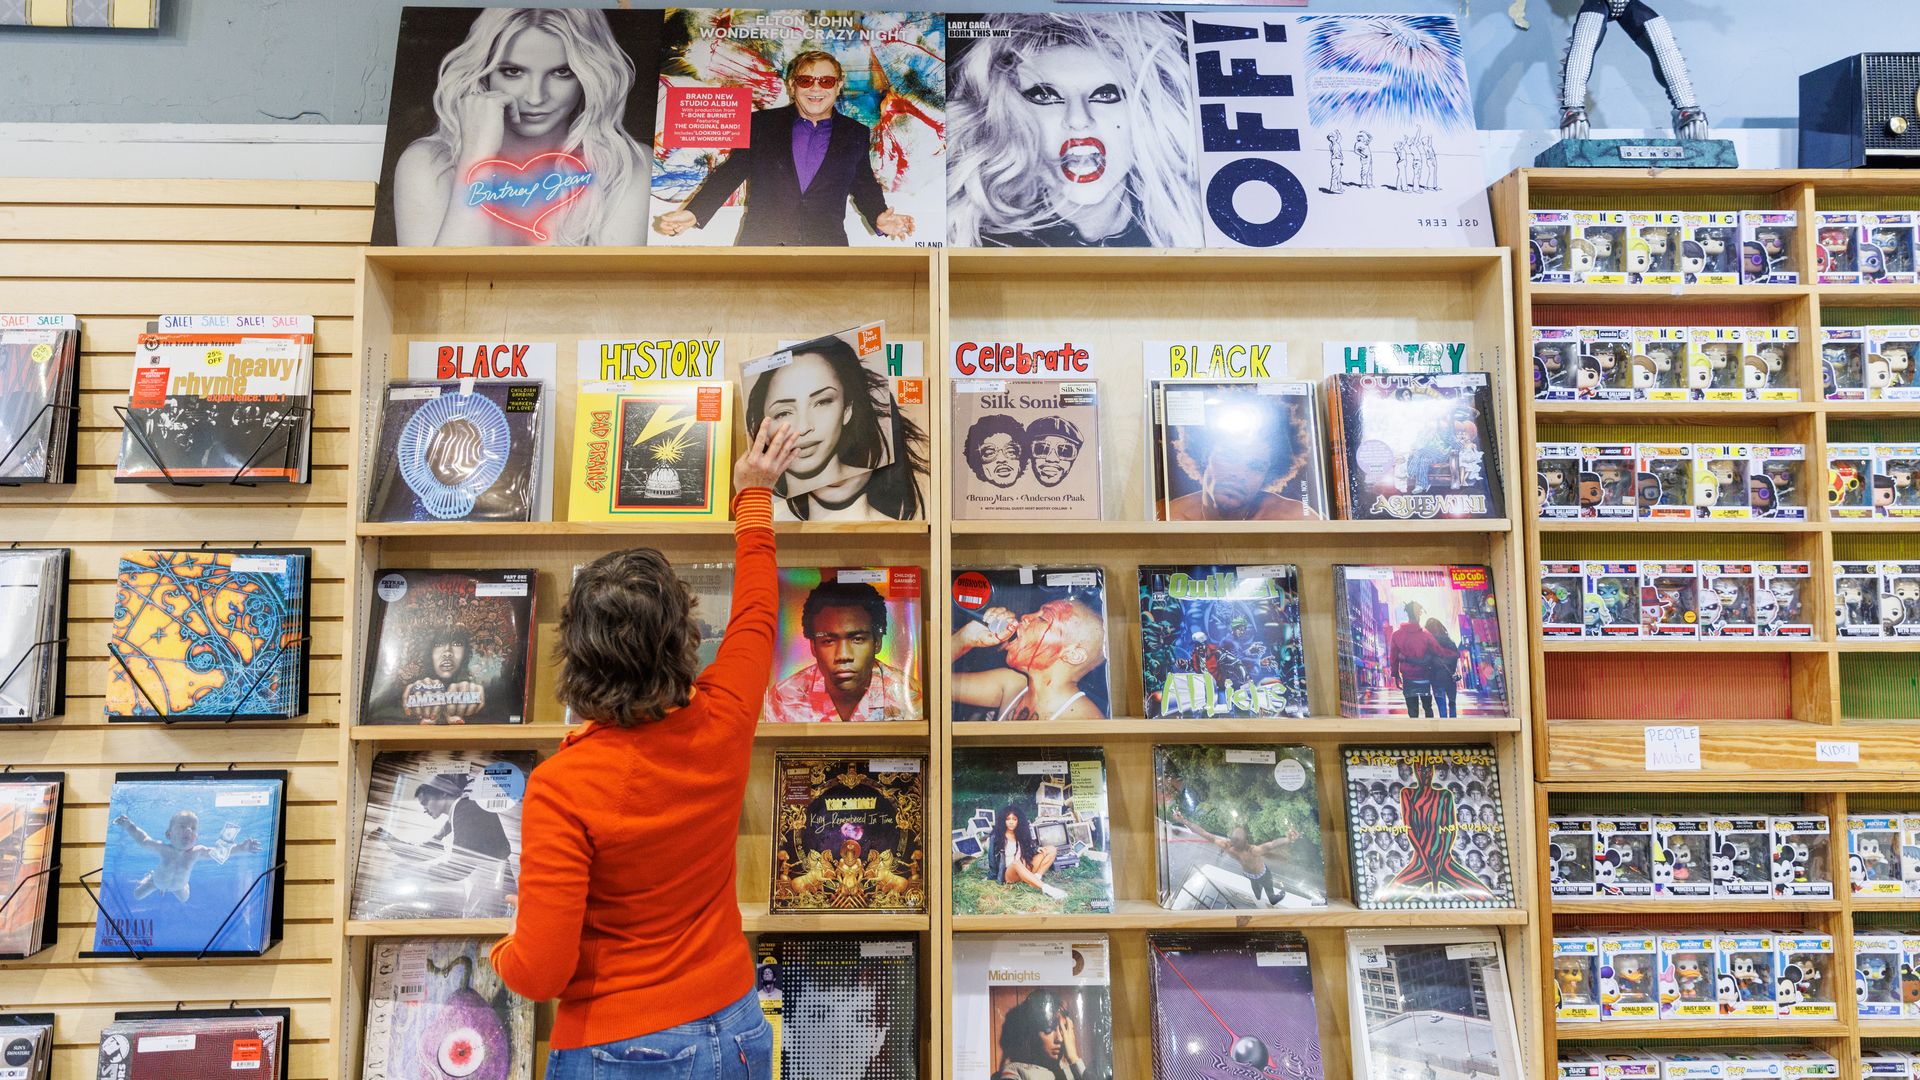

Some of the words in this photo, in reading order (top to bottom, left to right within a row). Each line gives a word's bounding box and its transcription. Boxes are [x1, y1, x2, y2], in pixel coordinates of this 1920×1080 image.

[756, 16, 804, 27] ELTON
[809, 16, 853, 27] JOHN
[700, 28, 802, 40] WONDERFUL
[805, 28, 855, 41] CRAZY
[859, 29, 908, 41] NIGHT
[1192, 19, 1308, 247] OFF!
[469, 174, 539, 207] Britney
[543, 173, 591, 200] Jean
[1, 316, 28, 327] SALE!
[37, 316, 63, 325] SALE!
[165, 316, 192, 328] SALE!
[201, 317, 229, 328] SALE!
[237, 316, 265, 327] SALE!
[272, 317, 298, 328] SALE!
[862, 329, 873, 337] The
[207, 350, 222, 358] 25%
[864, 345, 880, 355] Sade
[208, 357, 223, 365] OFF
[437, 345, 529, 378] BLACK
[600, 340, 720, 380] HISTORY
[956, 342, 1089, 375] Celebrate
[1170, 345, 1271, 377] BLACK
[226, 354, 295, 381] heavy
[172, 372, 248, 399] rhyme
[981, 389, 1016, 409] Silk
[591, 411, 611, 439] BAD
[586, 441, 609, 493] BRAINS
[966, 494, 993, 502] Bruno
[992, 494, 1014, 504] Mars
[1021, 494, 1060, 502] Anderson
[1370, 494, 1487, 518] AQUEMINI
[1648, 728, 1697, 741] PEOPLE
[1820, 745, 1851, 757] KIDS!
[1451, 753, 1490, 766] Quest
[1653, 753, 1695, 765] MUSIC
[810, 813, 833, 834] King
[831, 813, 866, 827] Remembered
[869, 814, 878, 824] In
[880, 814, 893, 824] Time
[988, 970, 1041, 983] Midnights
